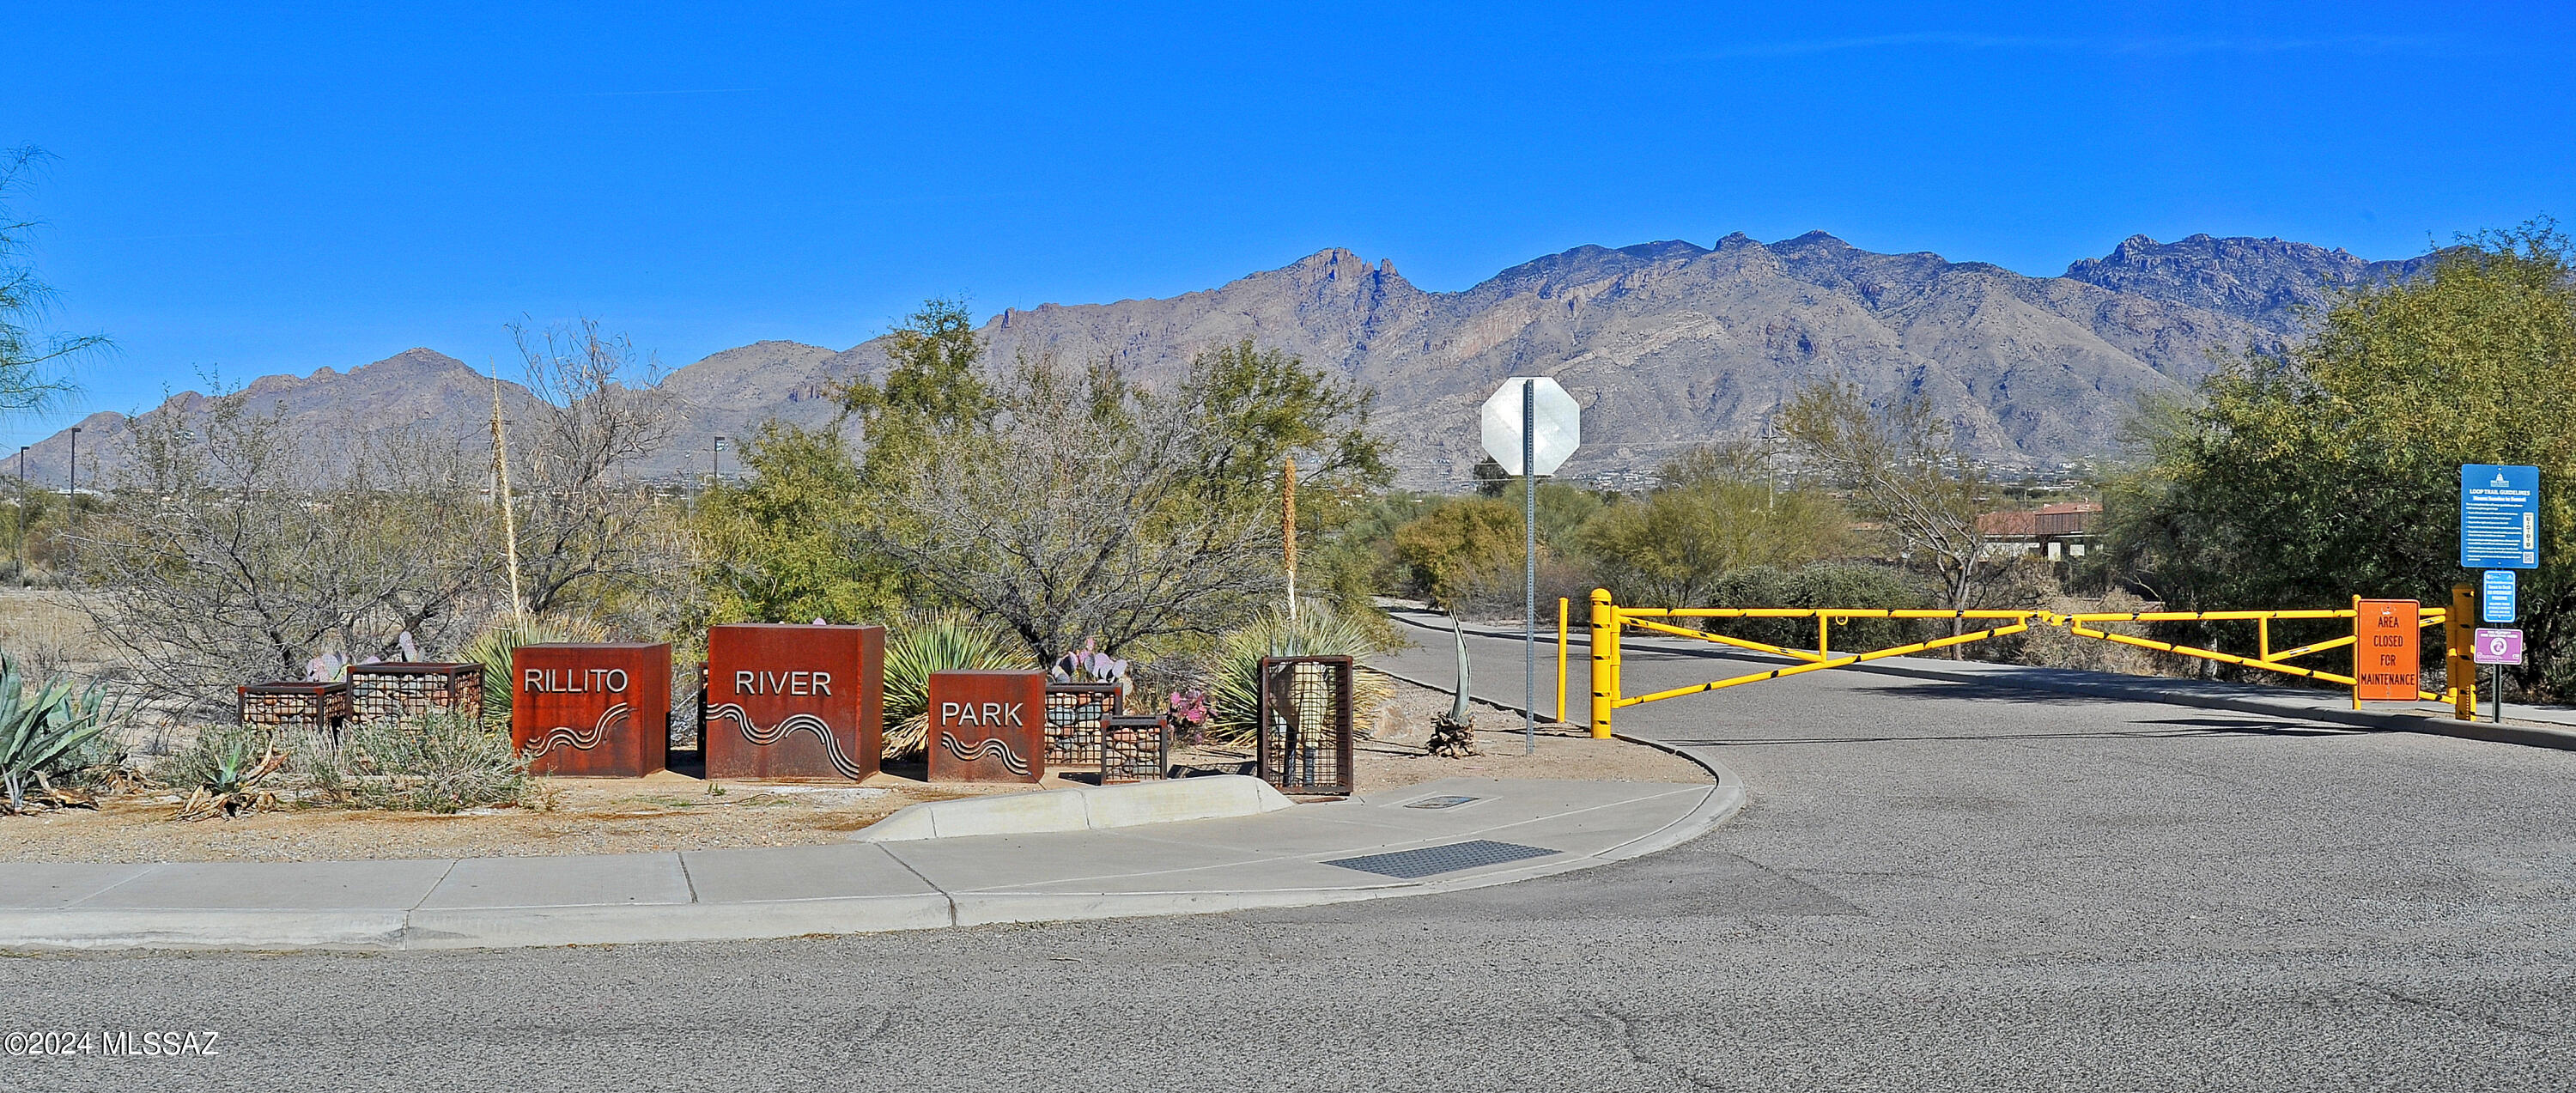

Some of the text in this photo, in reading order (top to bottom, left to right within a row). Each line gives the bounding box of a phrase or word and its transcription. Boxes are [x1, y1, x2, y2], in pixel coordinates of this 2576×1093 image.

[2378, 616, 2399, 628] AREA
[2373, 635, 2403, 647] CLOSED
[2380, 654, 2396, 666] FOR
[524, 668, 629, 693] RILLITO
[735, 670, 832, 696] RIVER
[2360, 673, 2415, 686] MAINTENANCE
[941, 701, 1024, 727] PARK
